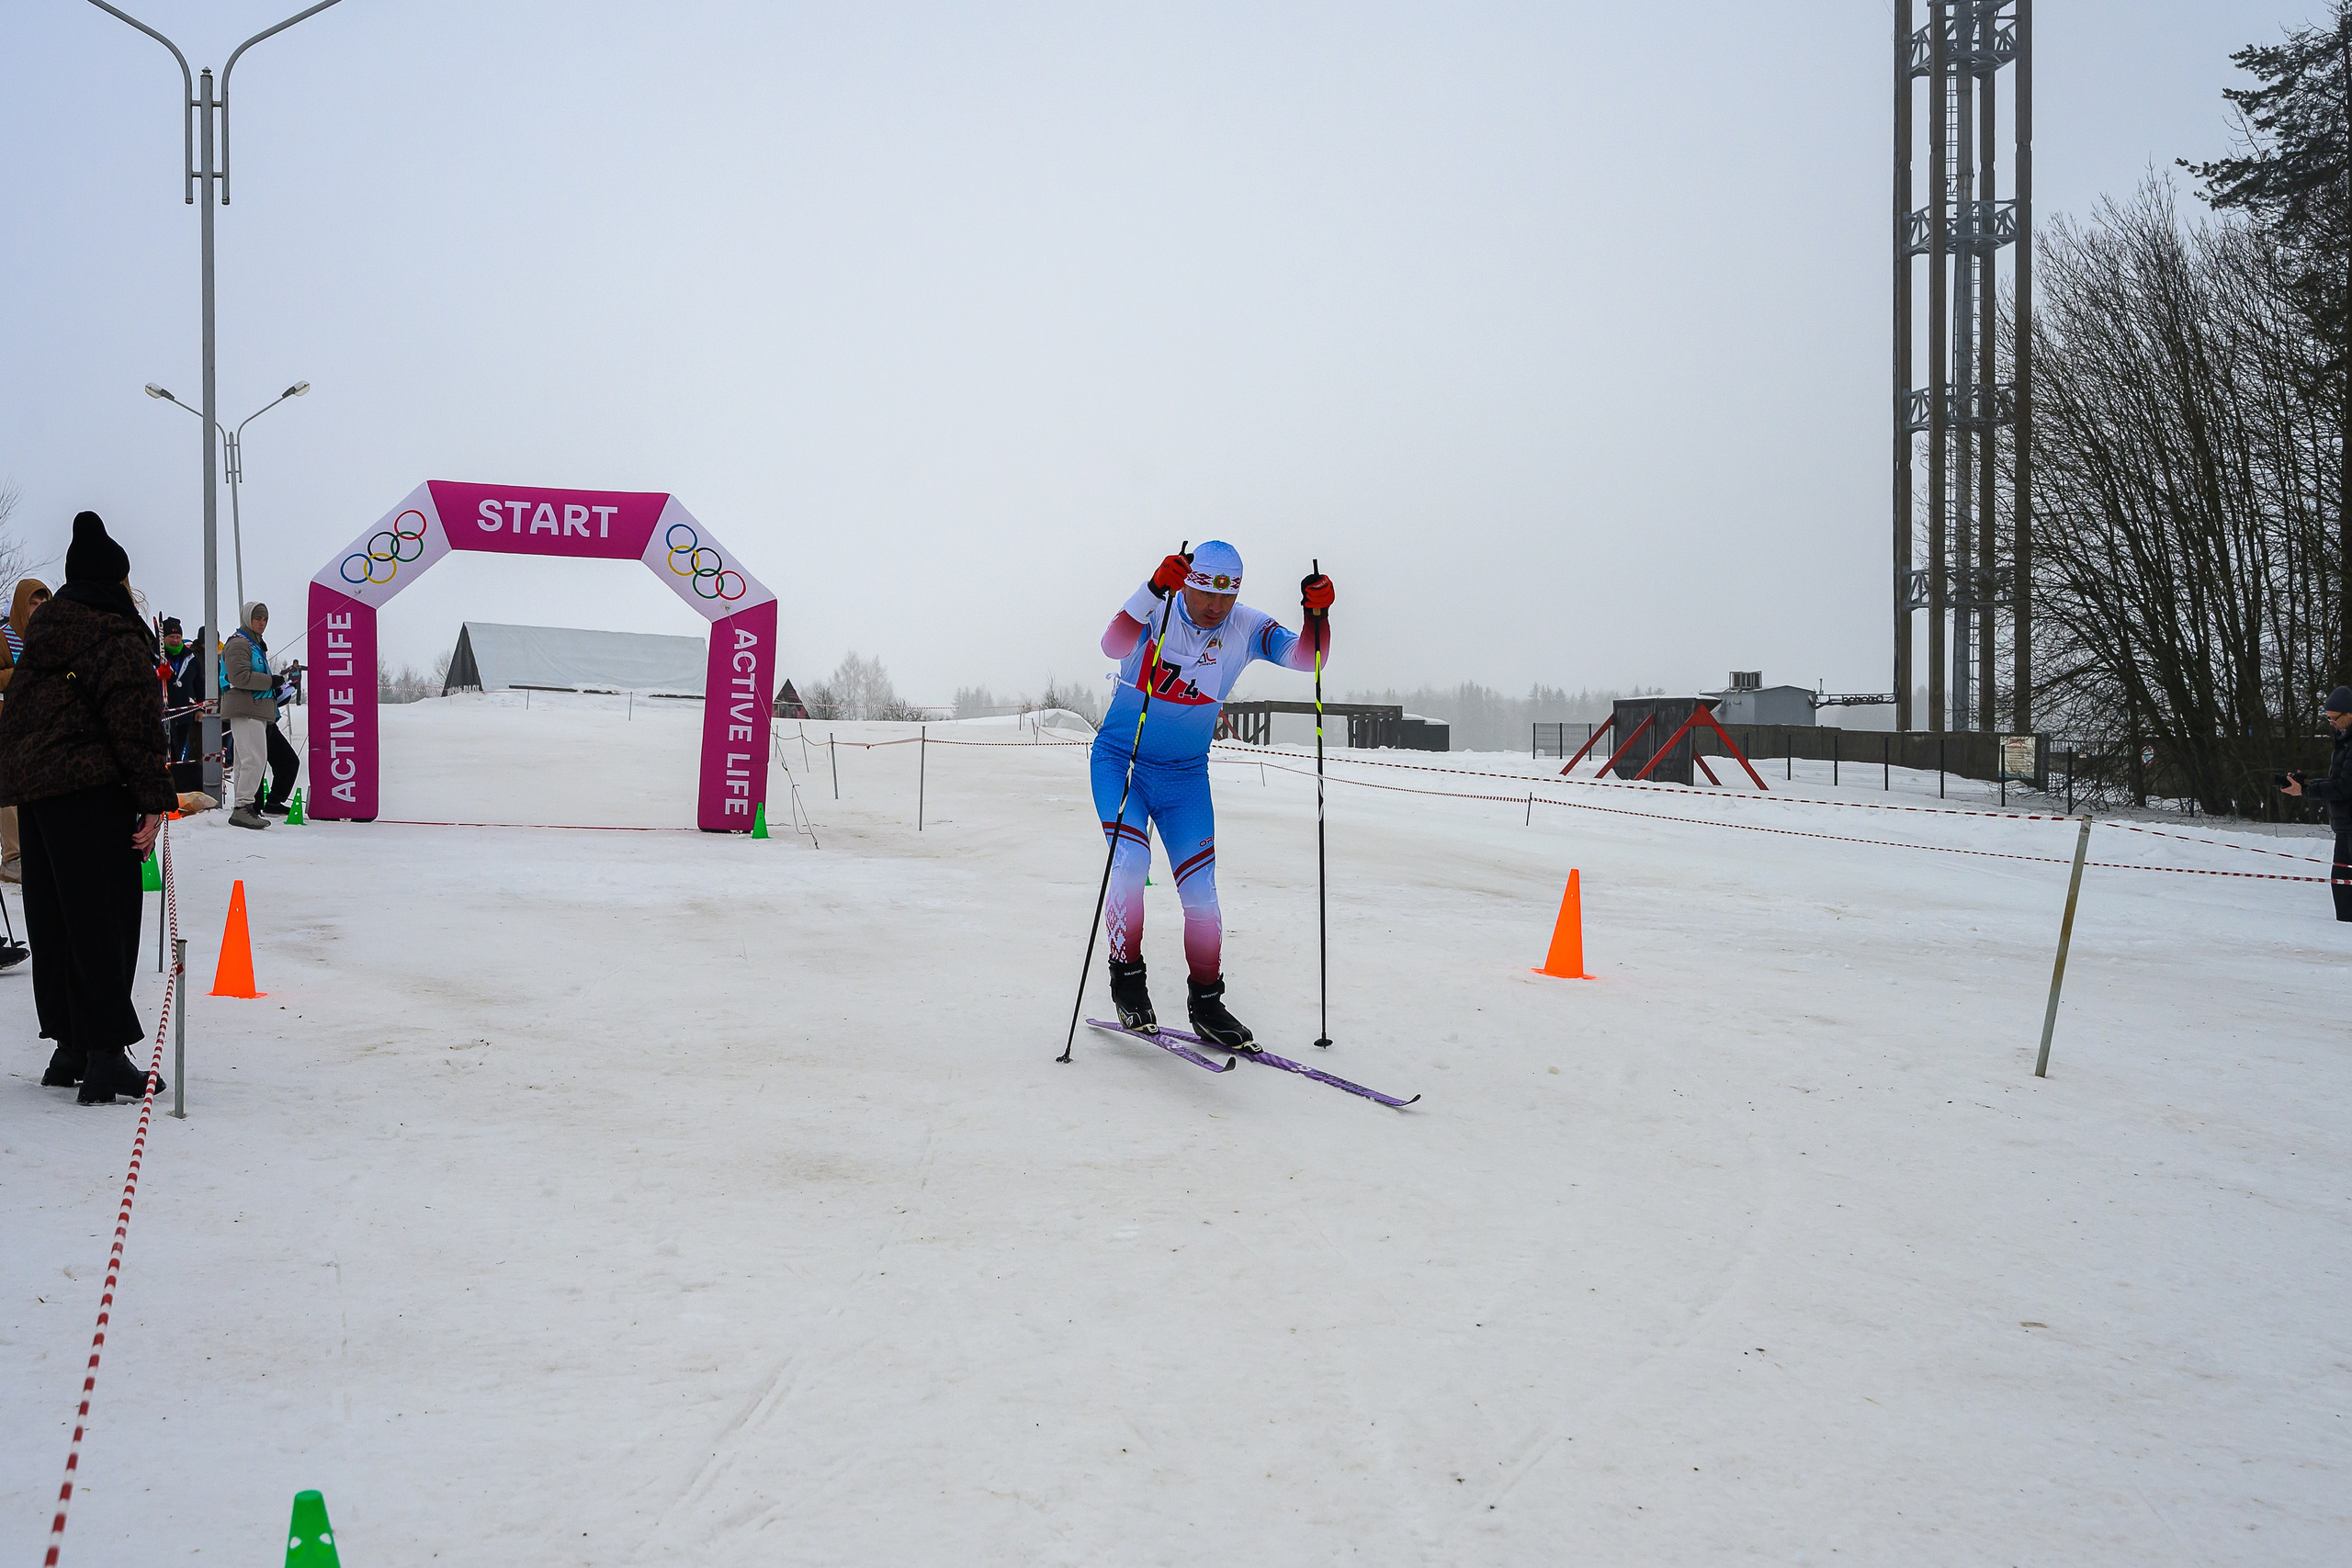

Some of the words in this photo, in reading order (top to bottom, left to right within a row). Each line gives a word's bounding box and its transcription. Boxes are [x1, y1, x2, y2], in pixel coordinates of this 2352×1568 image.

[477, 499, 618, 538] START
[327, 612, 353, 676] LIFE
[729, 628, 758, 742] ACTIVE
[329, 687, 356, 803] ACTIVE
[724, 752, 751, 816] LIFE
